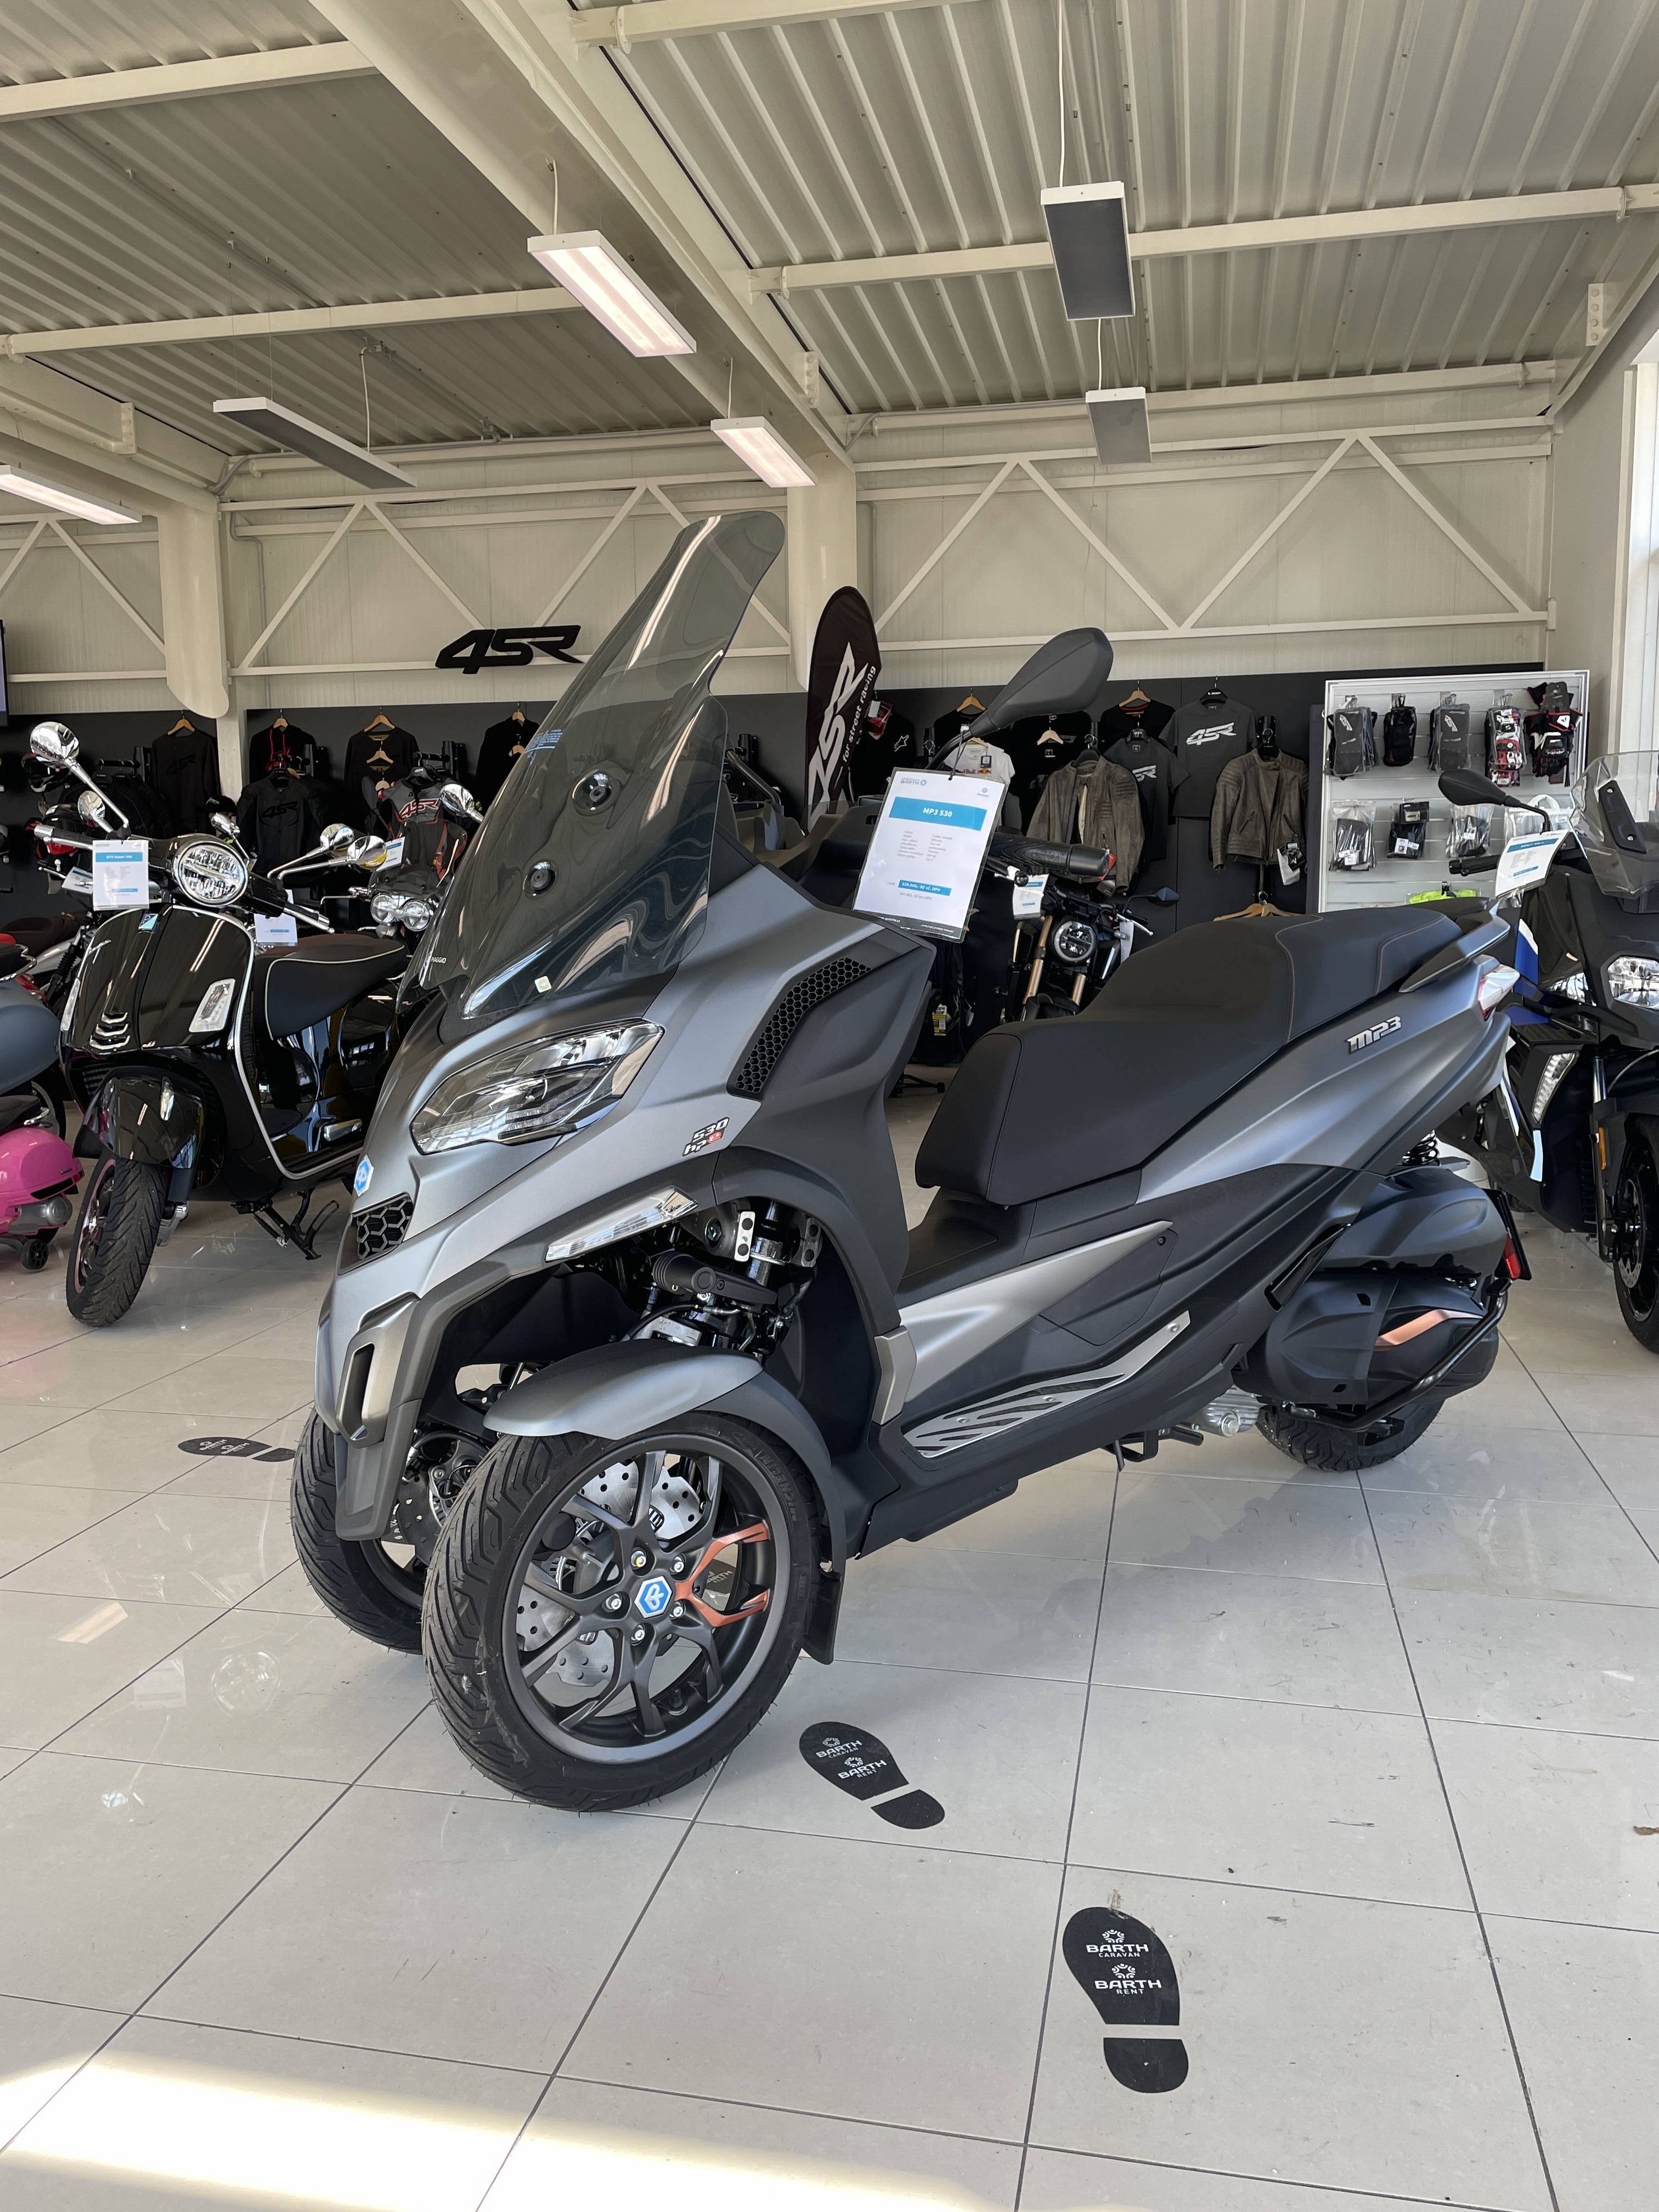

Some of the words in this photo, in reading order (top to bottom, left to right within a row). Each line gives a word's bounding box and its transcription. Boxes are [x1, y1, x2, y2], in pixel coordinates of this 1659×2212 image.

[435, 625, 585, 674] 4SR
[849, 705, 861, 742] street
[860, 665, 876, 704] racing
[1186, 722, 1237, 746] 4SR
[1132, 765, 1157, 782] SR
[923, 807, 938, 815] MP3
[939, 809, 953, 817] 530
[1347, 1015, 1401, 1053] MP3
[692, 1118, 729, 1143] 530
[707, 1570, 733, 1583] ARTH
[816, 1740, 862, 1758] BARTH
[828, 1747, 859, 1758] CARAVAN
[838, 1760, 887, 1779] BARTH
[856, 1770, 877, 1778] RENT
[1086, 1944, 1149, 1953] BARTH
[1094, 1979, 1162, 1989] BARTH
